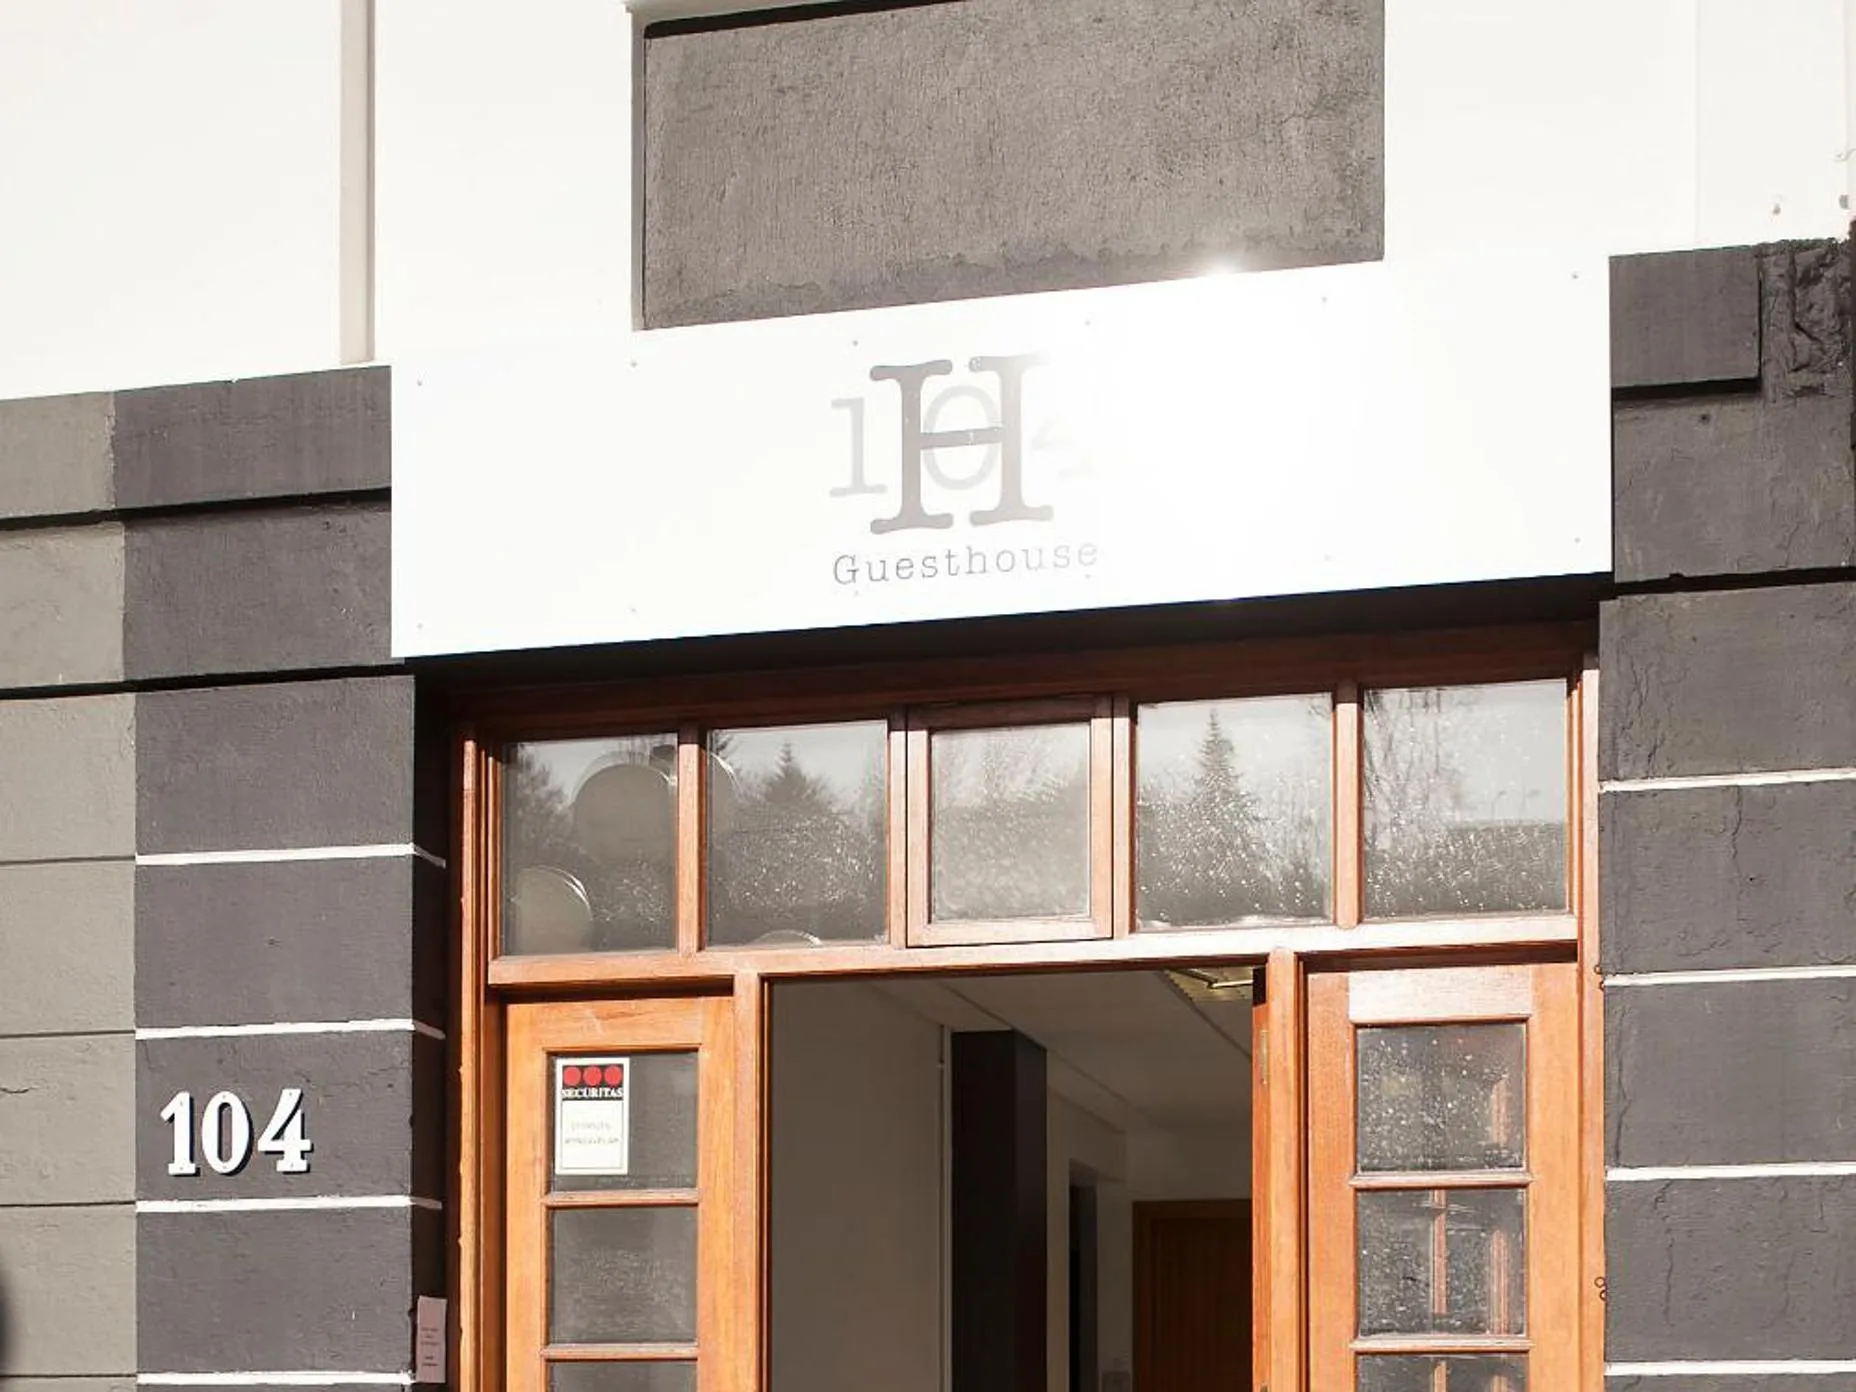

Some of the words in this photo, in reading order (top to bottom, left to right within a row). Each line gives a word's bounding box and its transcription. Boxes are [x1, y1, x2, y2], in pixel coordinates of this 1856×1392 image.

[832, 542, 1098, 585] Guesthouse
[561, 1086, 624, 1099] SECURITAS
[160, 1088, 313, 1175] 104
